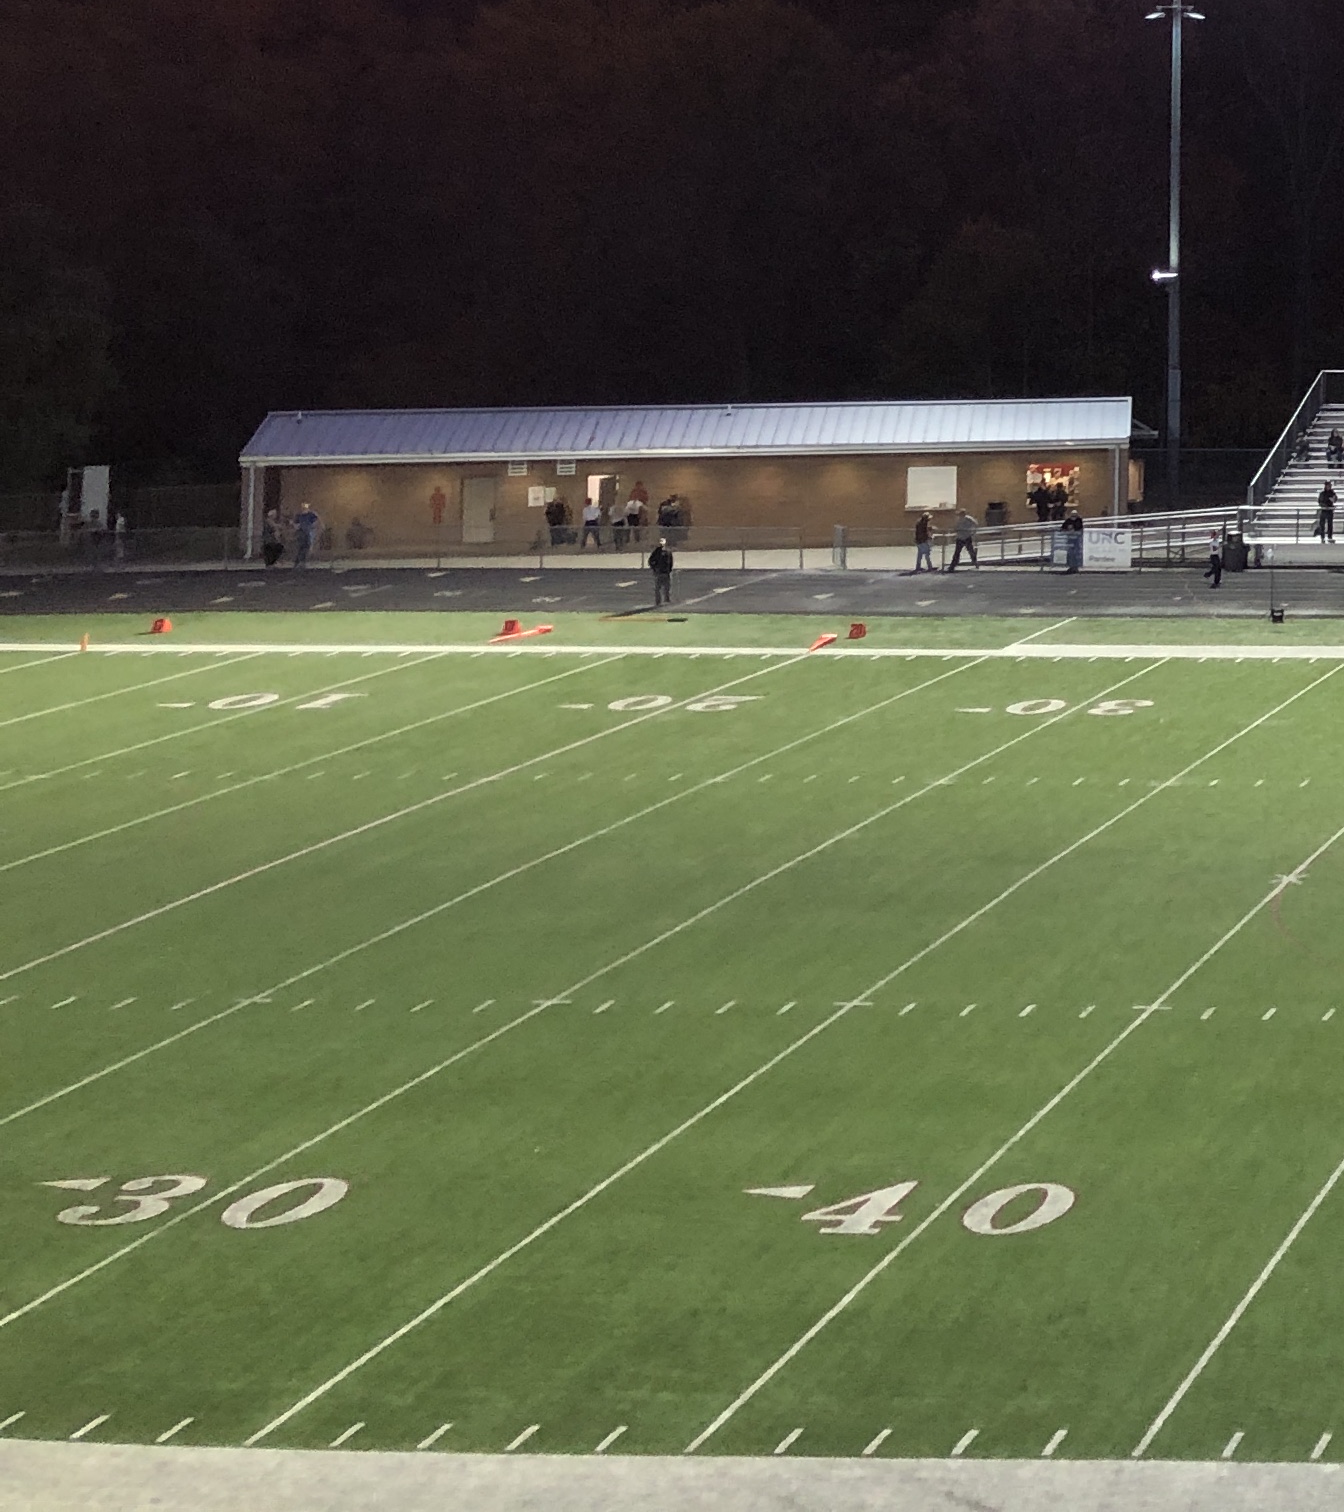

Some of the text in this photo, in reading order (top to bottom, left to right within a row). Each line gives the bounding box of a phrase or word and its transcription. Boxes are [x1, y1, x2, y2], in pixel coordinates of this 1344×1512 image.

[1088, 531, 1125, 545] UNC
[56, 1174, 349, 1229] 30
[800, 1180, 1076, 1235] 40
